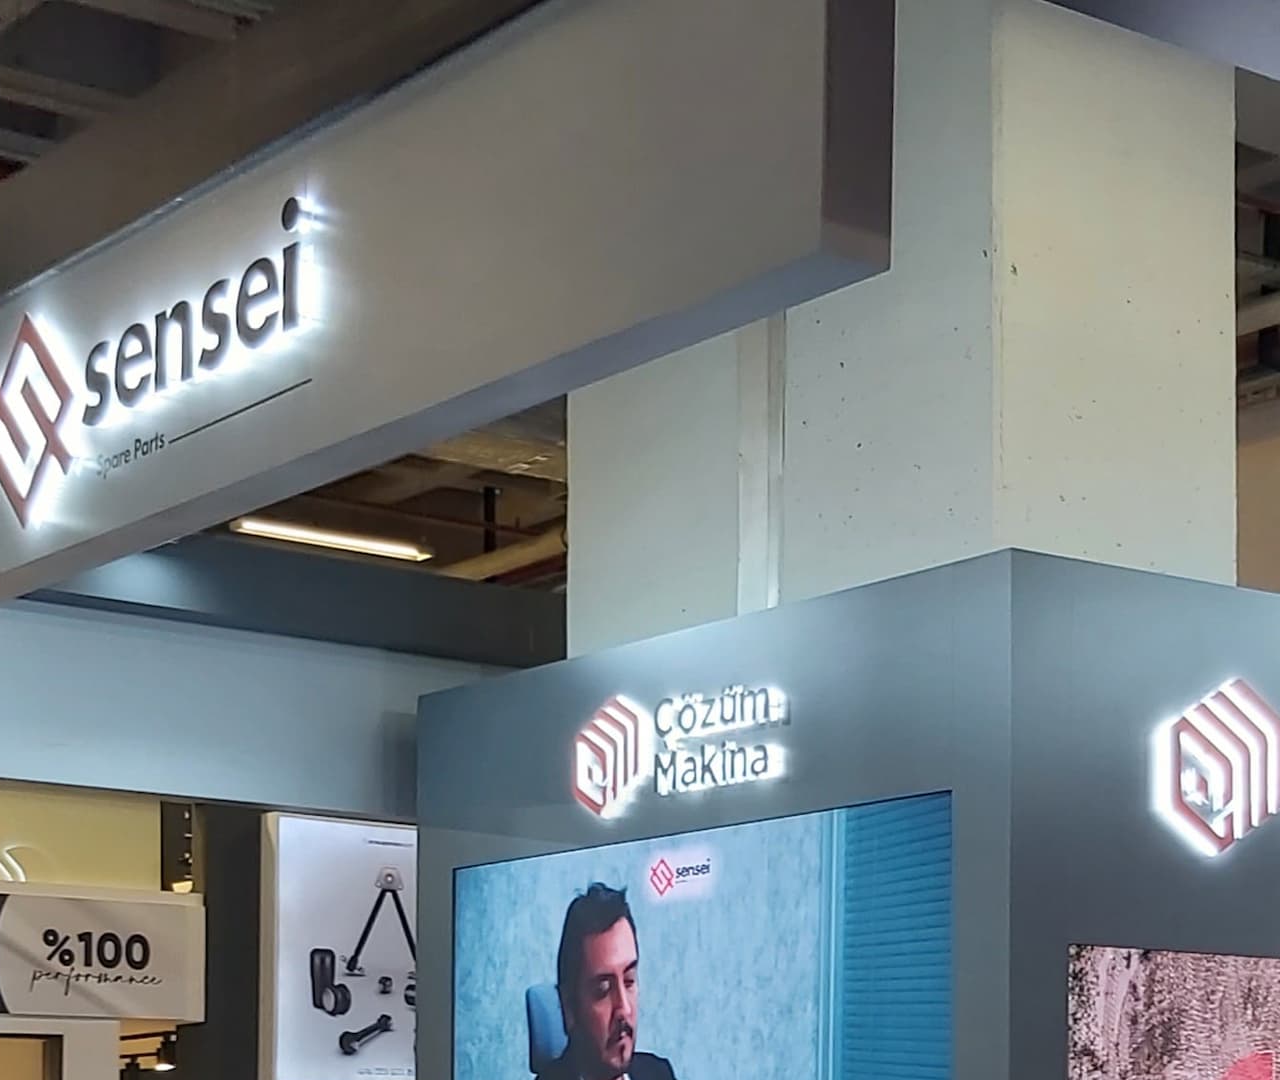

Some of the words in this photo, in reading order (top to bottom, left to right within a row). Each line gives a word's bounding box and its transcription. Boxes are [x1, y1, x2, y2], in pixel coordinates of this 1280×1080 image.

[82, 196, 304, 427] sensei
[96, 449, 131, 480] Spare
[134, 432, 165, 460] Parts
[654, 685, 770, 749] Çözüm
[654, 740, 769, 793] Makina
[675, 857, 711, 879] sensei
[42, 928, 150, 970] %100
[29, 967, 163, 996] performance
